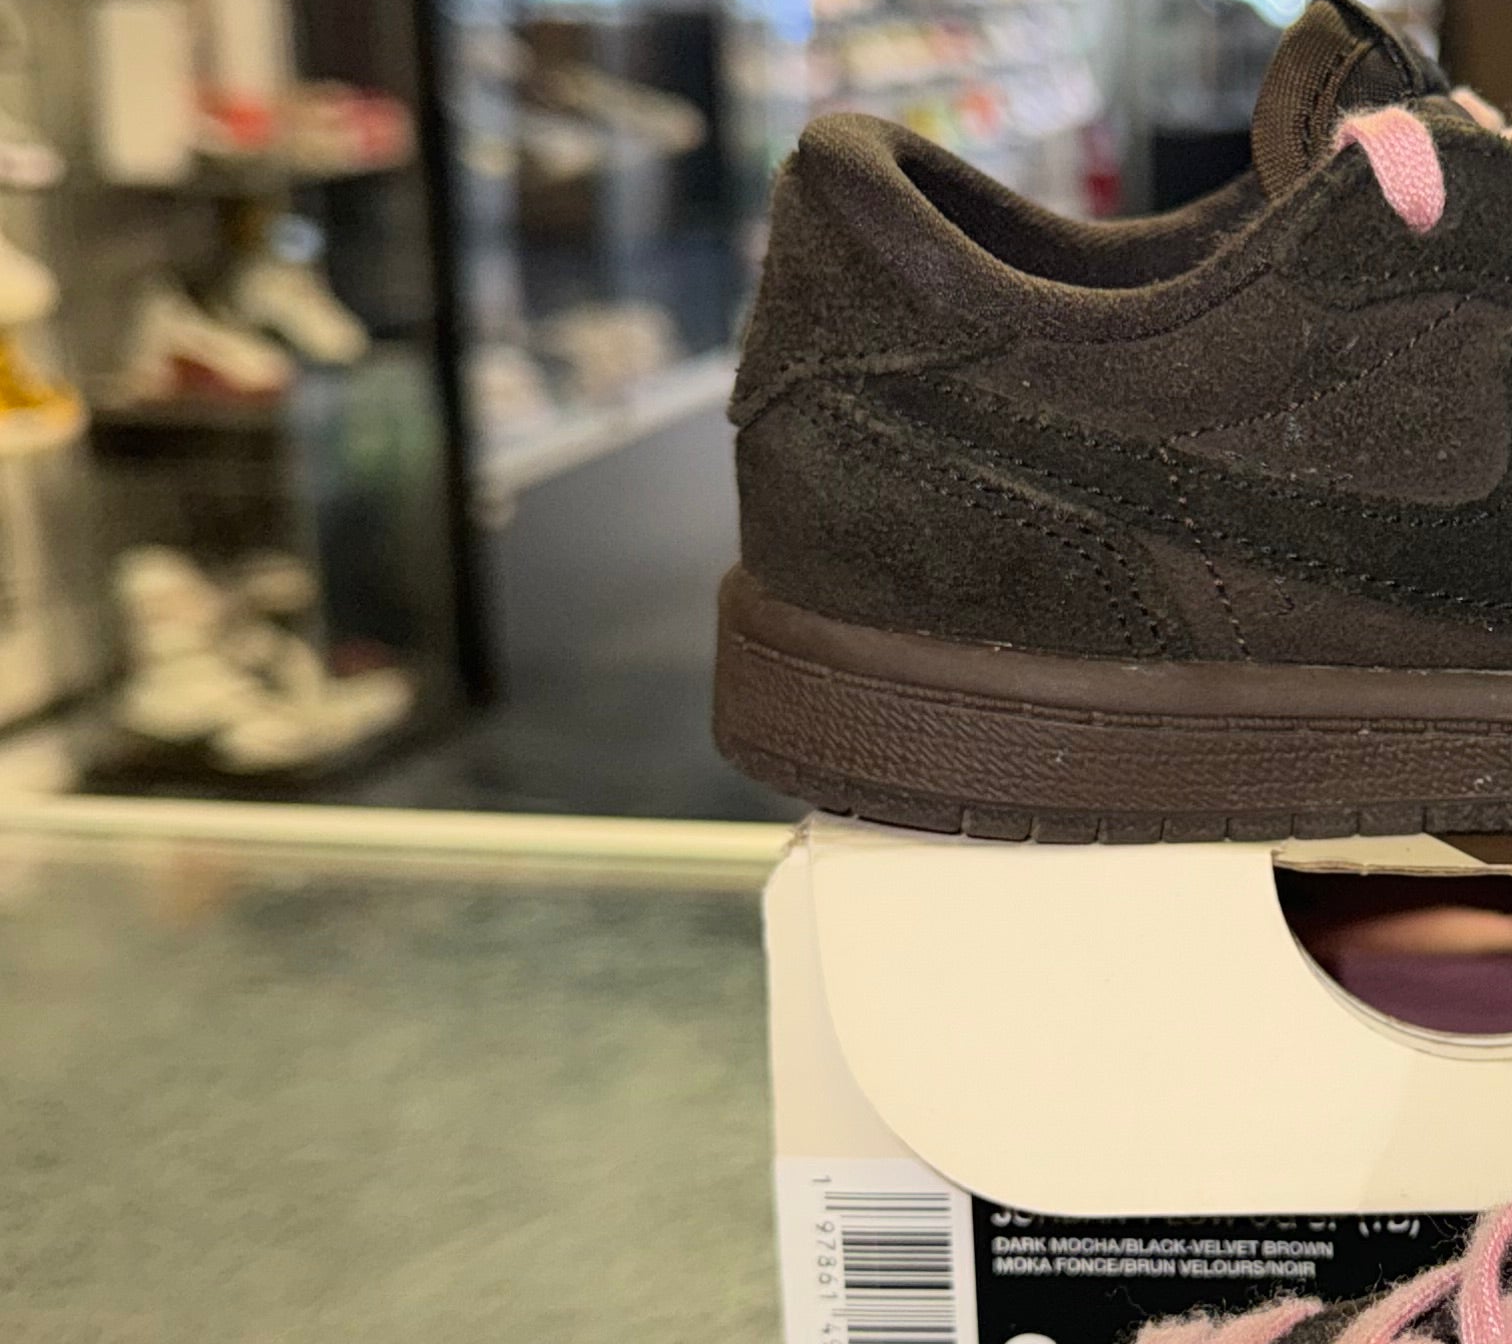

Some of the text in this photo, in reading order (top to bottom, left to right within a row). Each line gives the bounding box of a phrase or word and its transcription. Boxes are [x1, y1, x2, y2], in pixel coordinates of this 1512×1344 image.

[992, 1236, 1334, 1260] DARK MOCHA/BLACK-VELVET BROWN
[992, 1256, 1052, 1276] MOKA
[1177, 1259, 1316, 1280] VELOURS/NOIR
